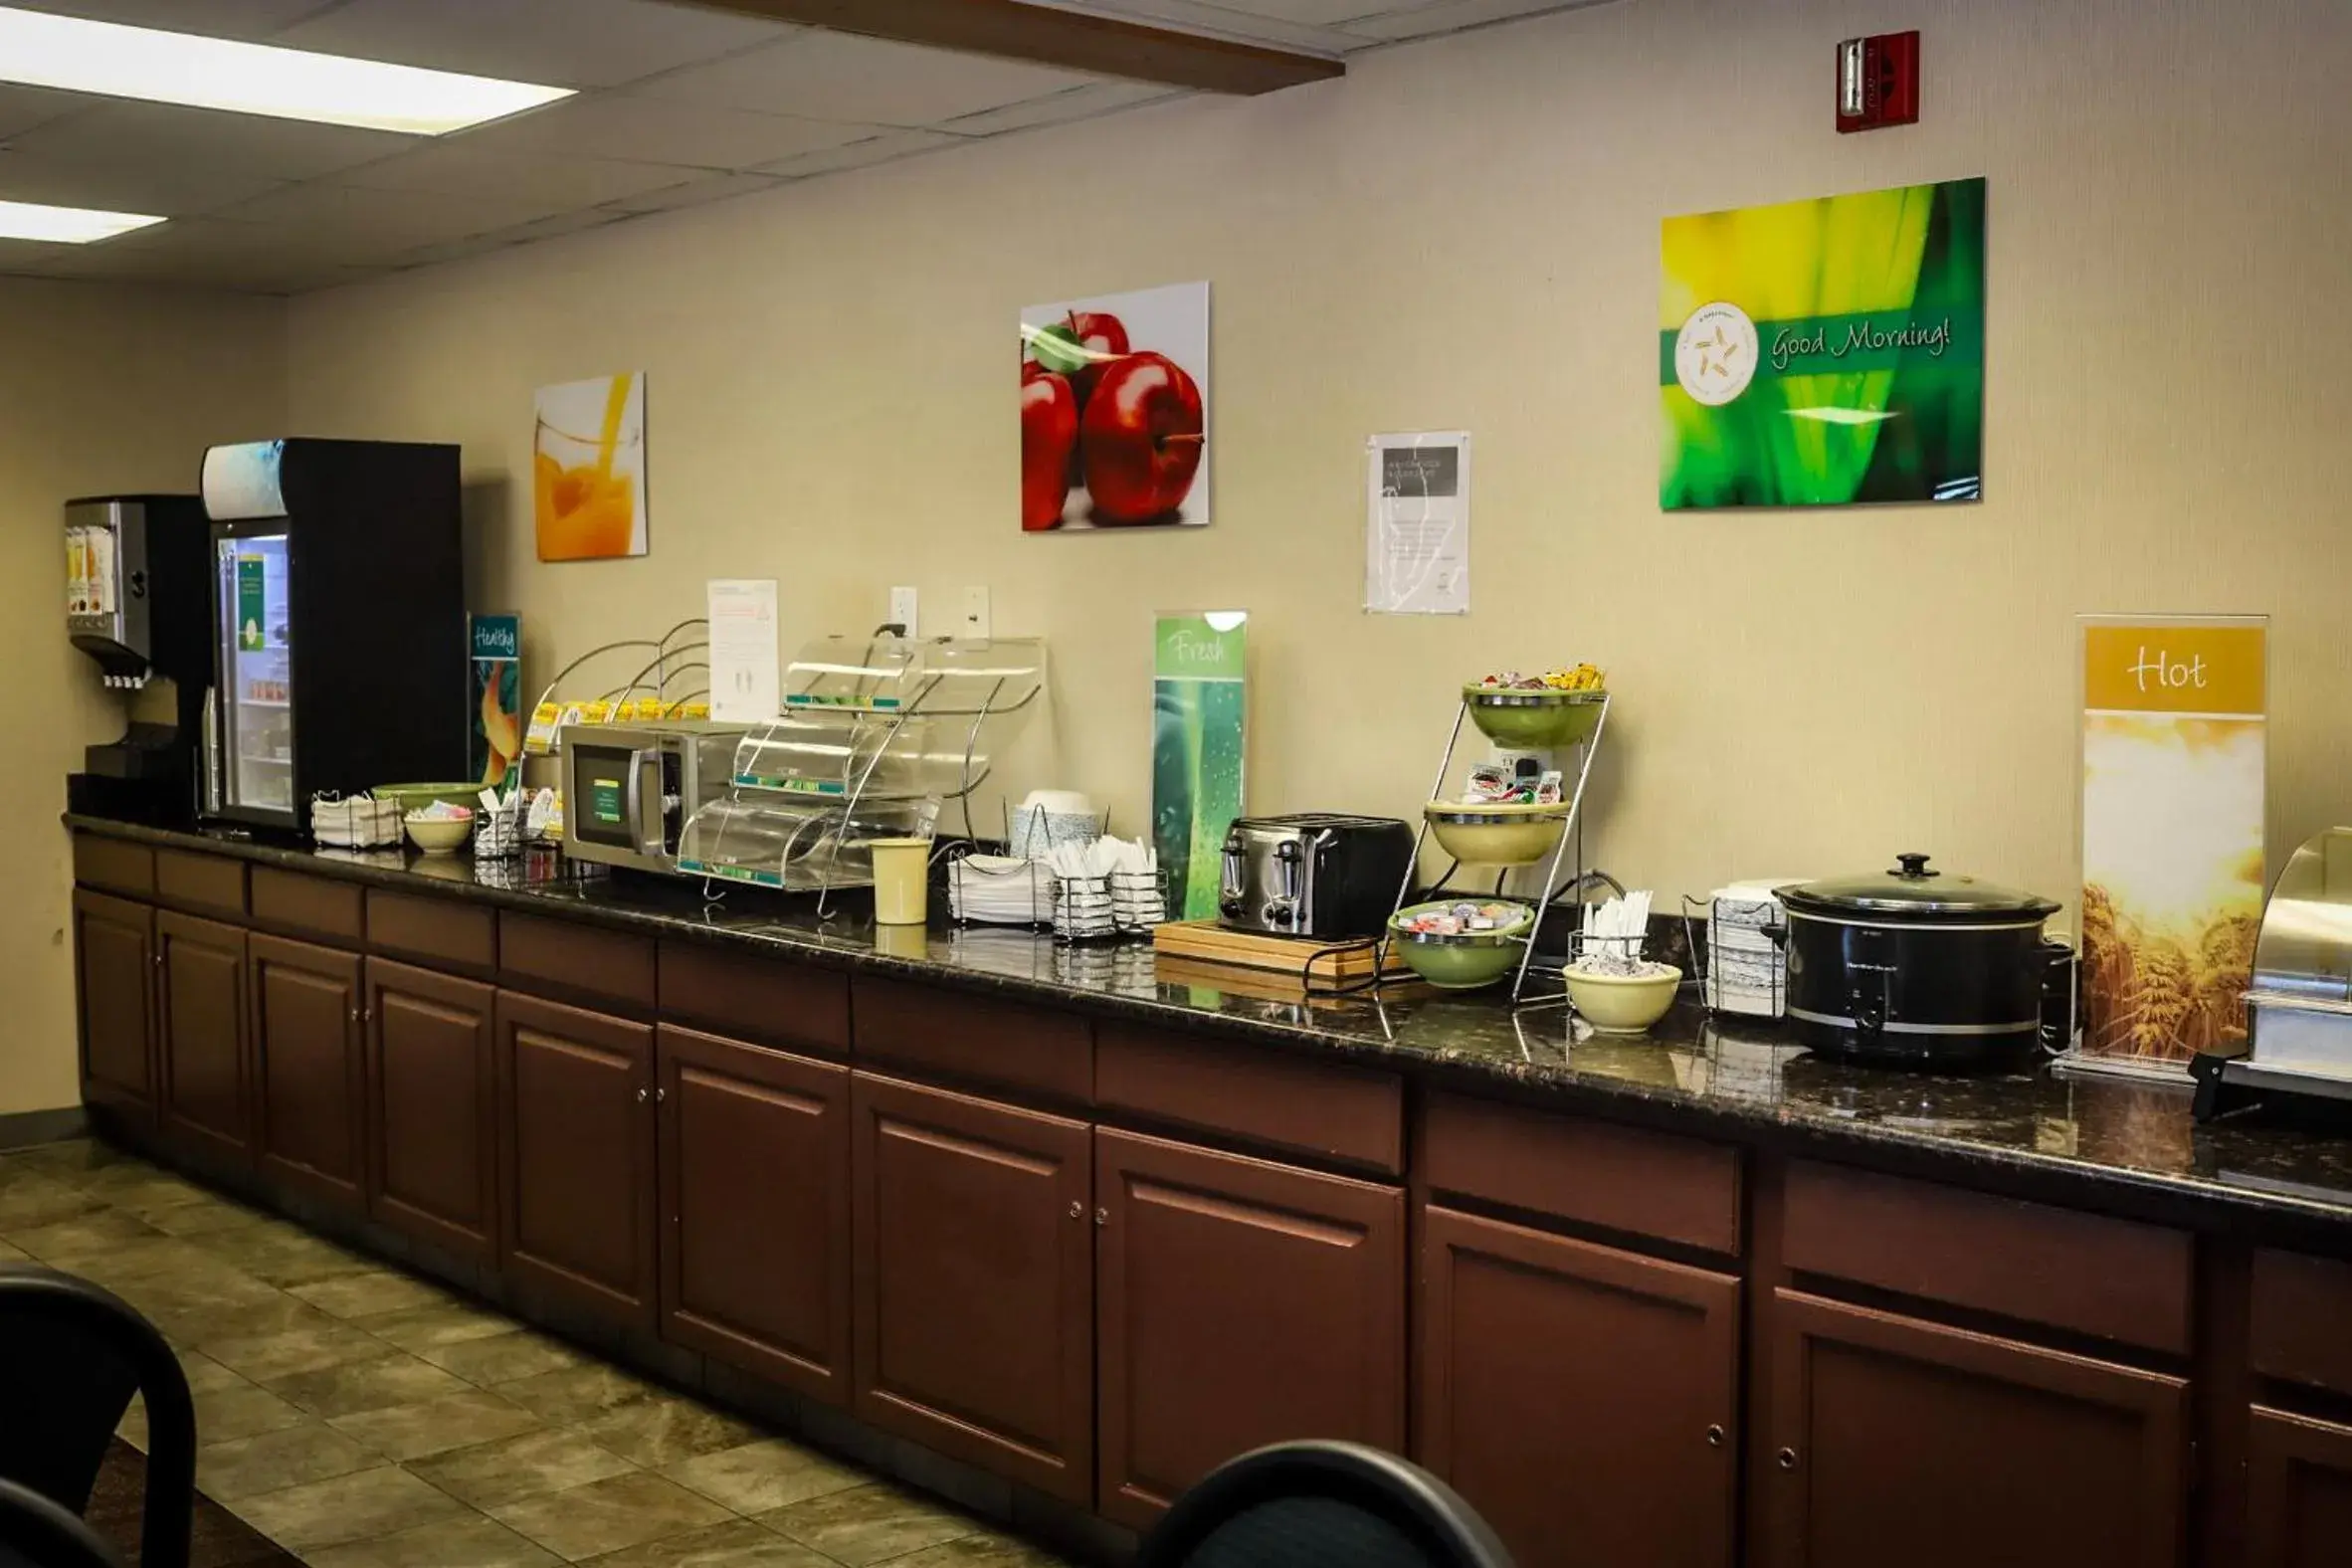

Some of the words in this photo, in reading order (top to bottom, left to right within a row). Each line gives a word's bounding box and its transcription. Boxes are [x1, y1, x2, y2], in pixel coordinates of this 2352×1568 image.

[1772, 327, 1825, 370] Good
[1831, 317, 1950, 356] Morning!
[475, 626, 515, 656] Healthy
[1166, 629, 1224, 665] Fresh
[2126, 646, 2207, 693] Hot
